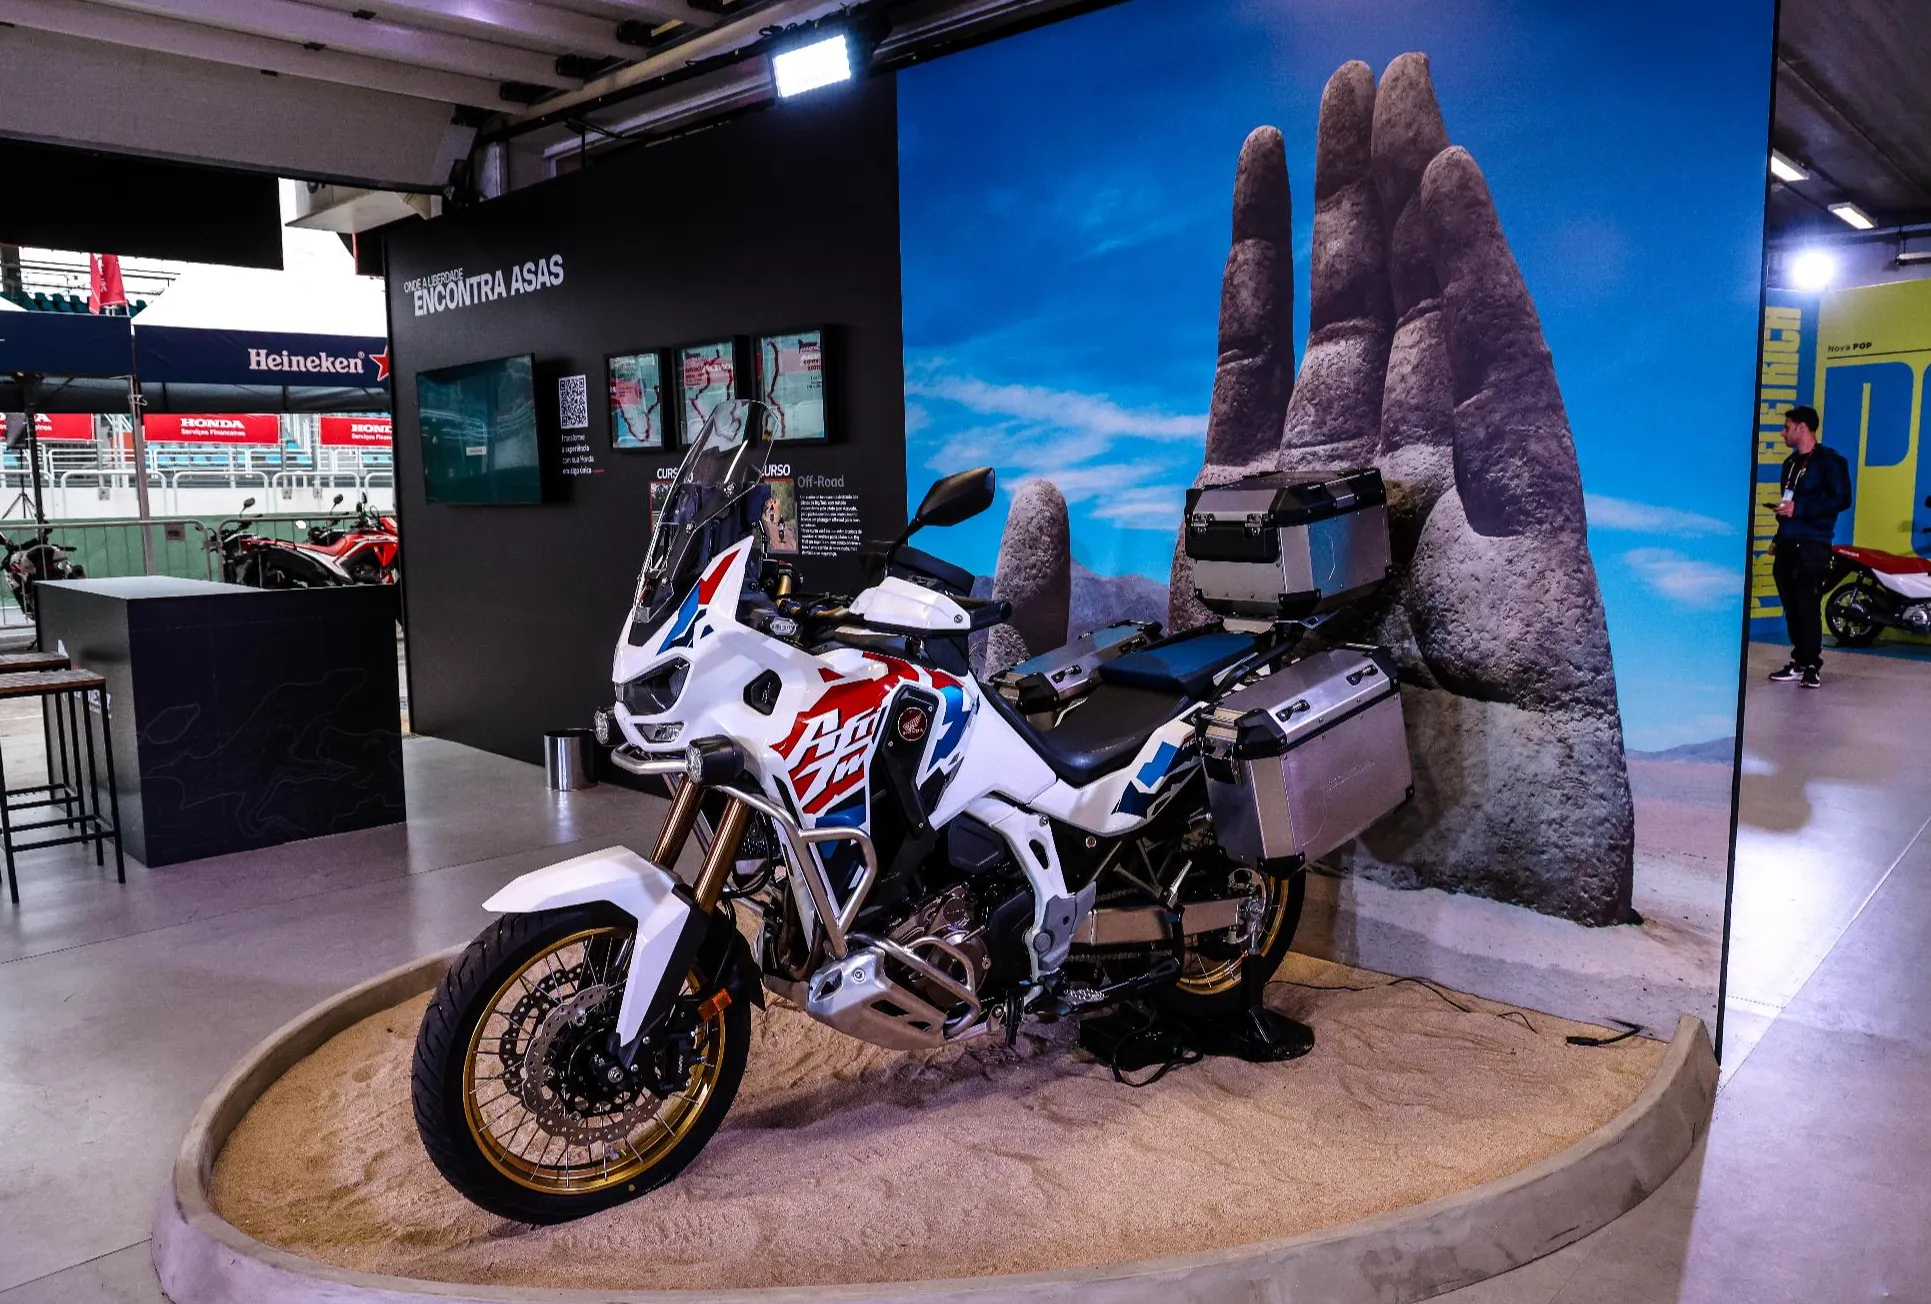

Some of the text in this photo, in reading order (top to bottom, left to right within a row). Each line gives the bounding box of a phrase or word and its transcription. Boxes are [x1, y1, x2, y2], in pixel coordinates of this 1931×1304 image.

[404, 267, 463, 293] ONDE A LIBERDADE
[414, 254, 564, 316] ENCONTRA ASAS
[1853, 342, 1872, 350] POP
[248, 348, 364, 373] Heineken
[181, 418, 246, 429] HONDA
[351, 424, 392, 433] HOND
[657, 467, 680, 479] CURS
[764, 464, 791, 476] URSO
[798, 474, 845, 488] Off-Road
